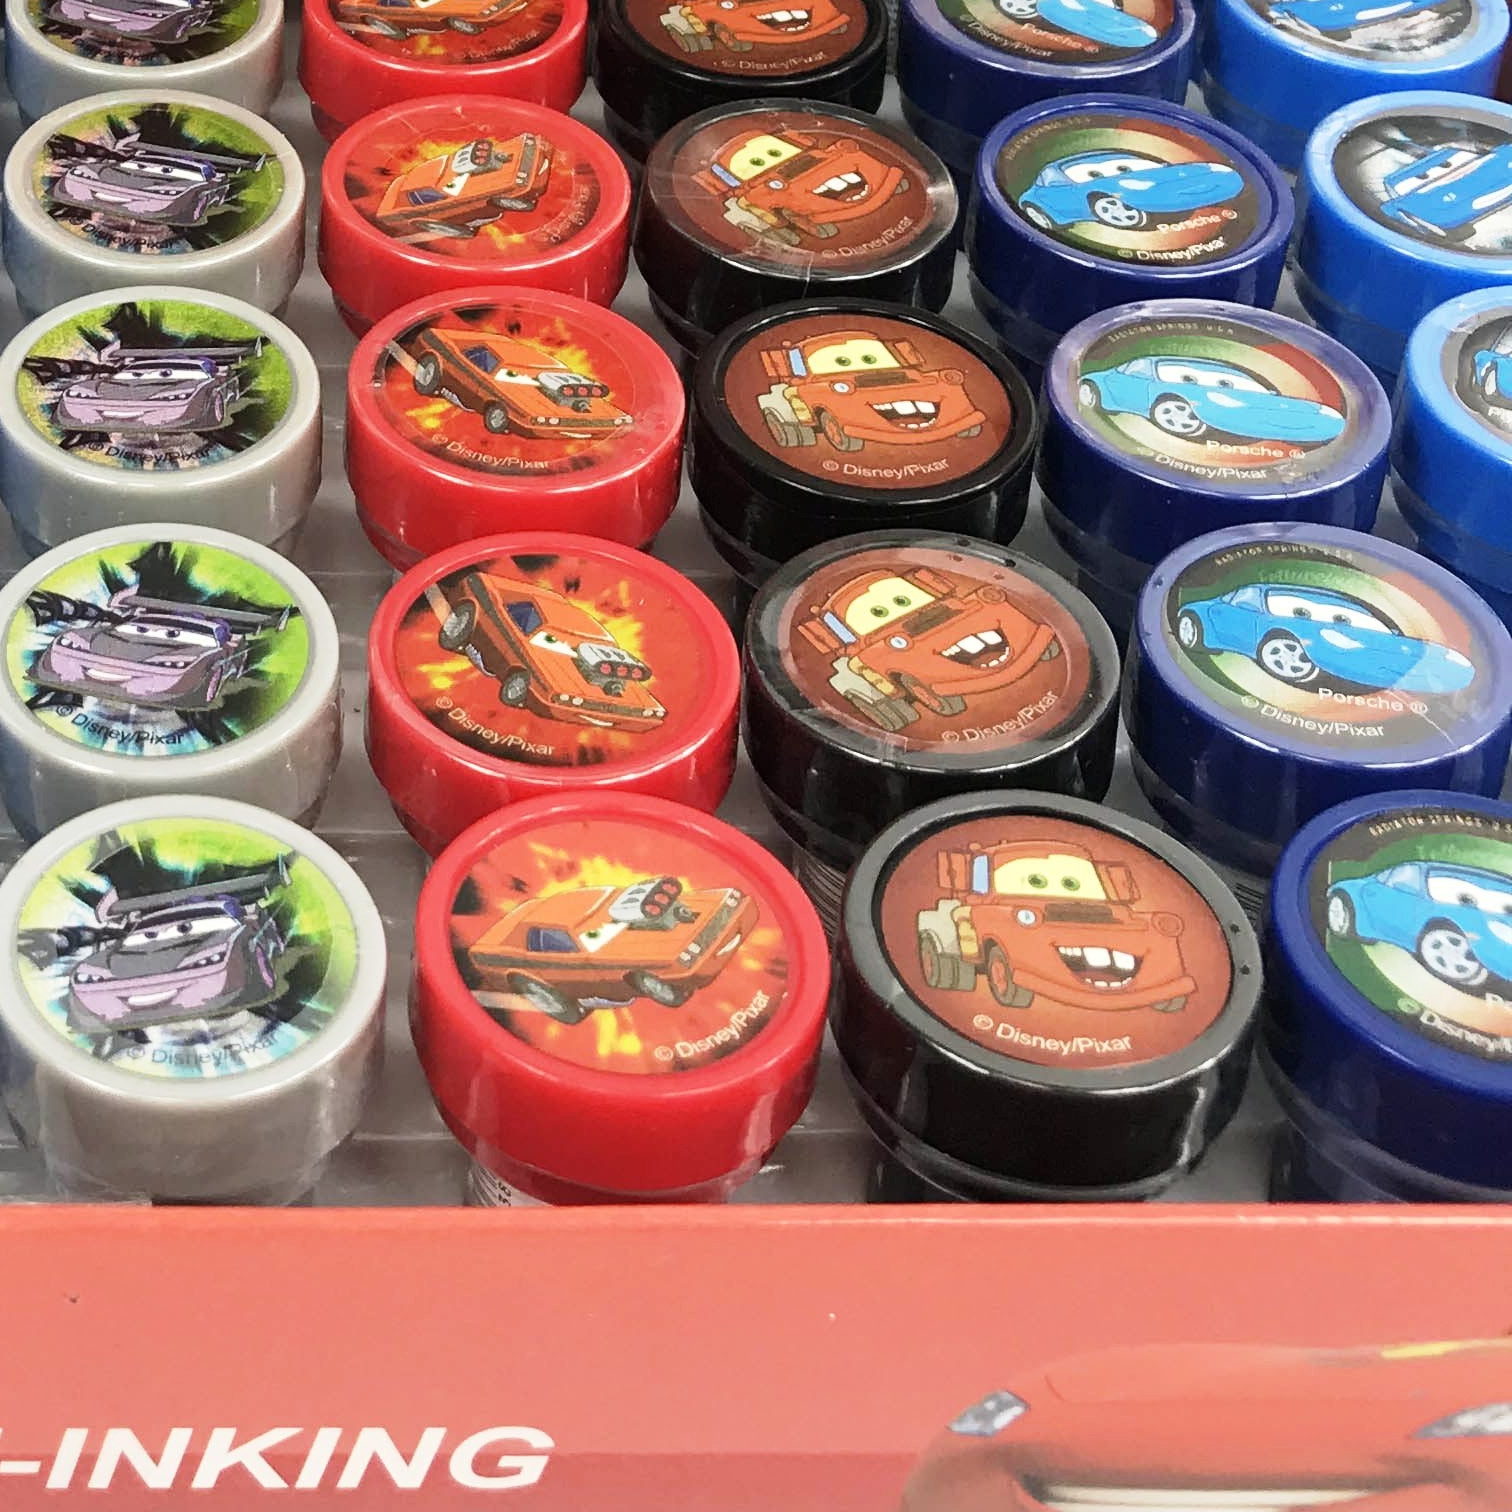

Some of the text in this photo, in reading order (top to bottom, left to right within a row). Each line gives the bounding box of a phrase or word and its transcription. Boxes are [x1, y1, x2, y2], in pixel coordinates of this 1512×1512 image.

[1205, 439, 1285, 458] Porsche
[1317, 687, 1404, 713] Porsche
[996, 1023, 1134, 1056] Disney/Pixar
